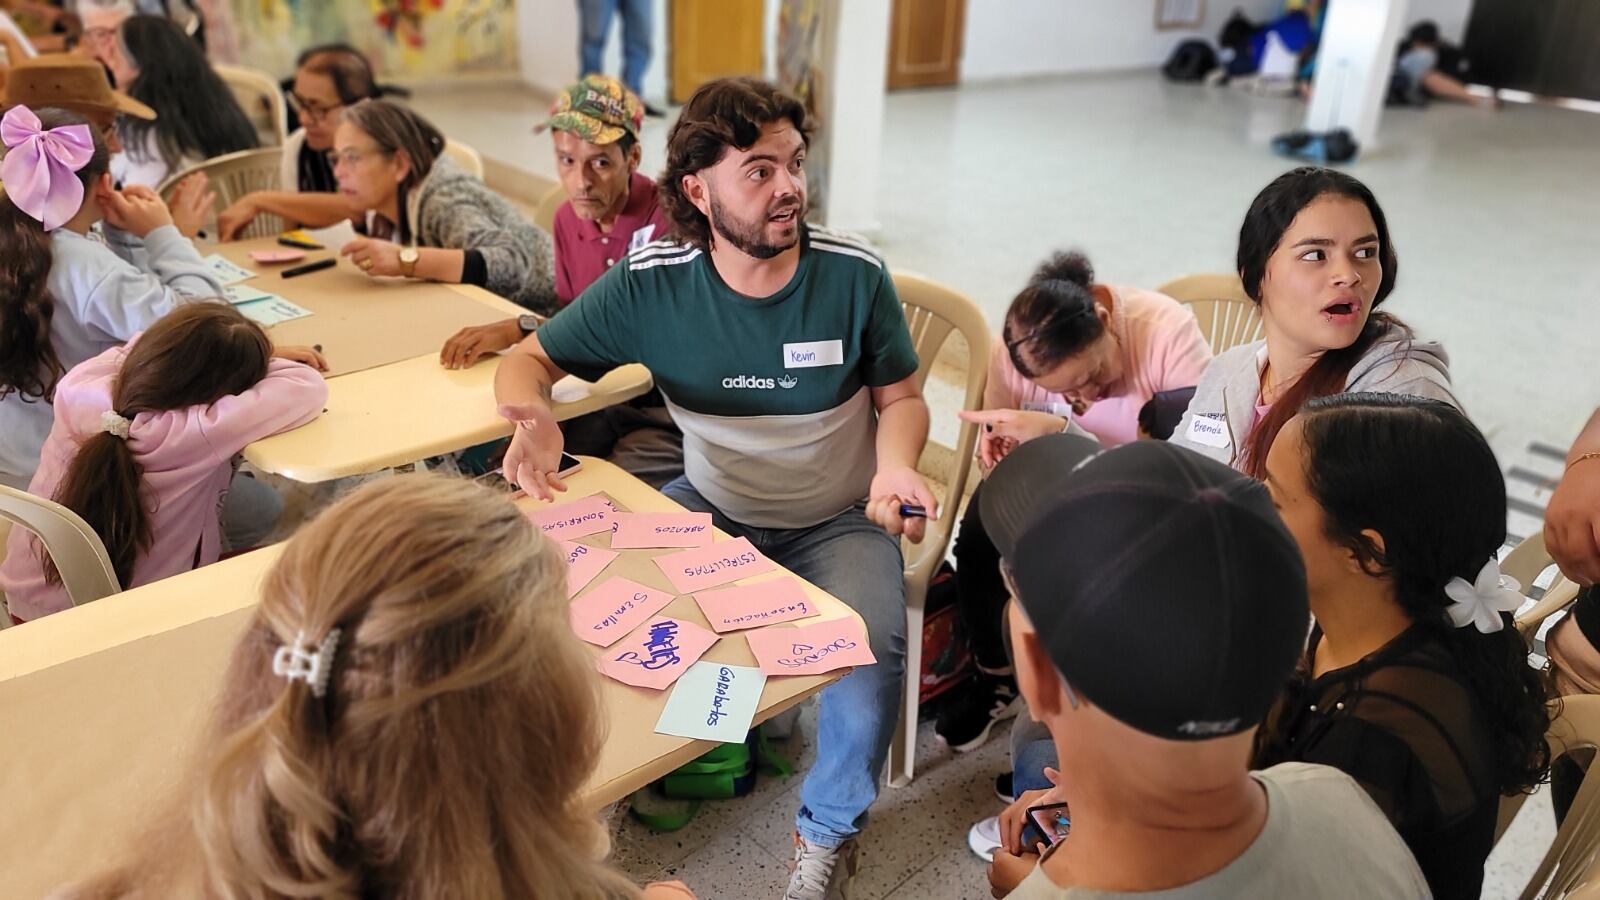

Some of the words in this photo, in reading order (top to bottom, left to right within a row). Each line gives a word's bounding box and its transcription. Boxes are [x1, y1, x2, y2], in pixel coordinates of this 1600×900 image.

[791, 350, 816, 362] Kevin
[723, 375, 775, 389] adidas
[654, 525, 706, 534] ABRAZOS
